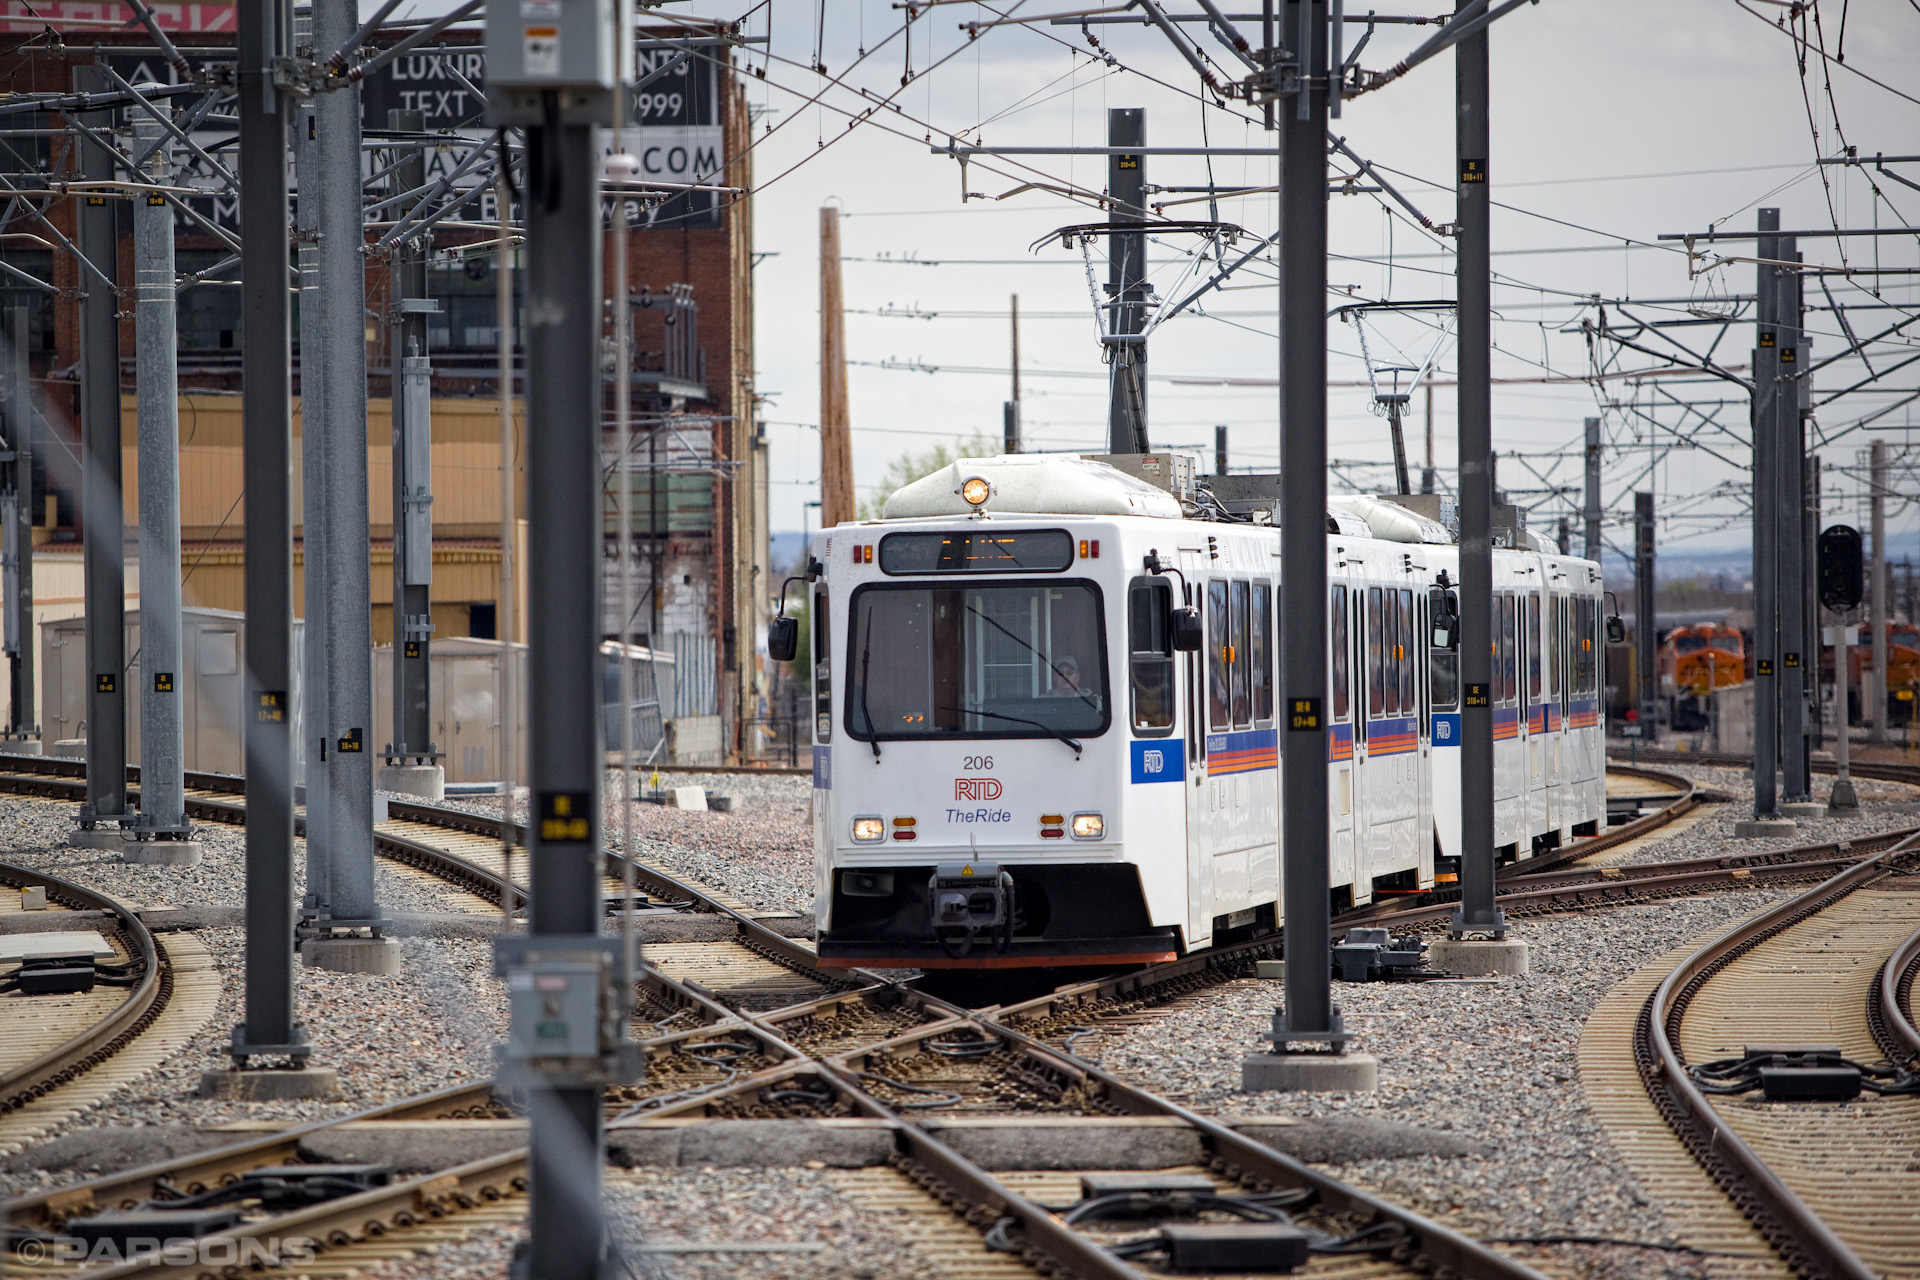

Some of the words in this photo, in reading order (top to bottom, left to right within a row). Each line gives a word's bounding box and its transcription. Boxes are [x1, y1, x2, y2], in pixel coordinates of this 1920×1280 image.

[391, 54, 487, 80] LUXUR
[400, 90, 468, 117] TEXT
[1469, 162, 1476, 170] SE
[1473, 686, 1479, 694] SE
[1466, 697, 1486, 705] 318+11
[1437, 721, 1451, 739] RTD
[963, 756, 994, 770] 206
[1144, 750, 1164, 773] RTD
[955, 778, 1003, 800] RTD
[945, 808, 1011, 823] TheRide
